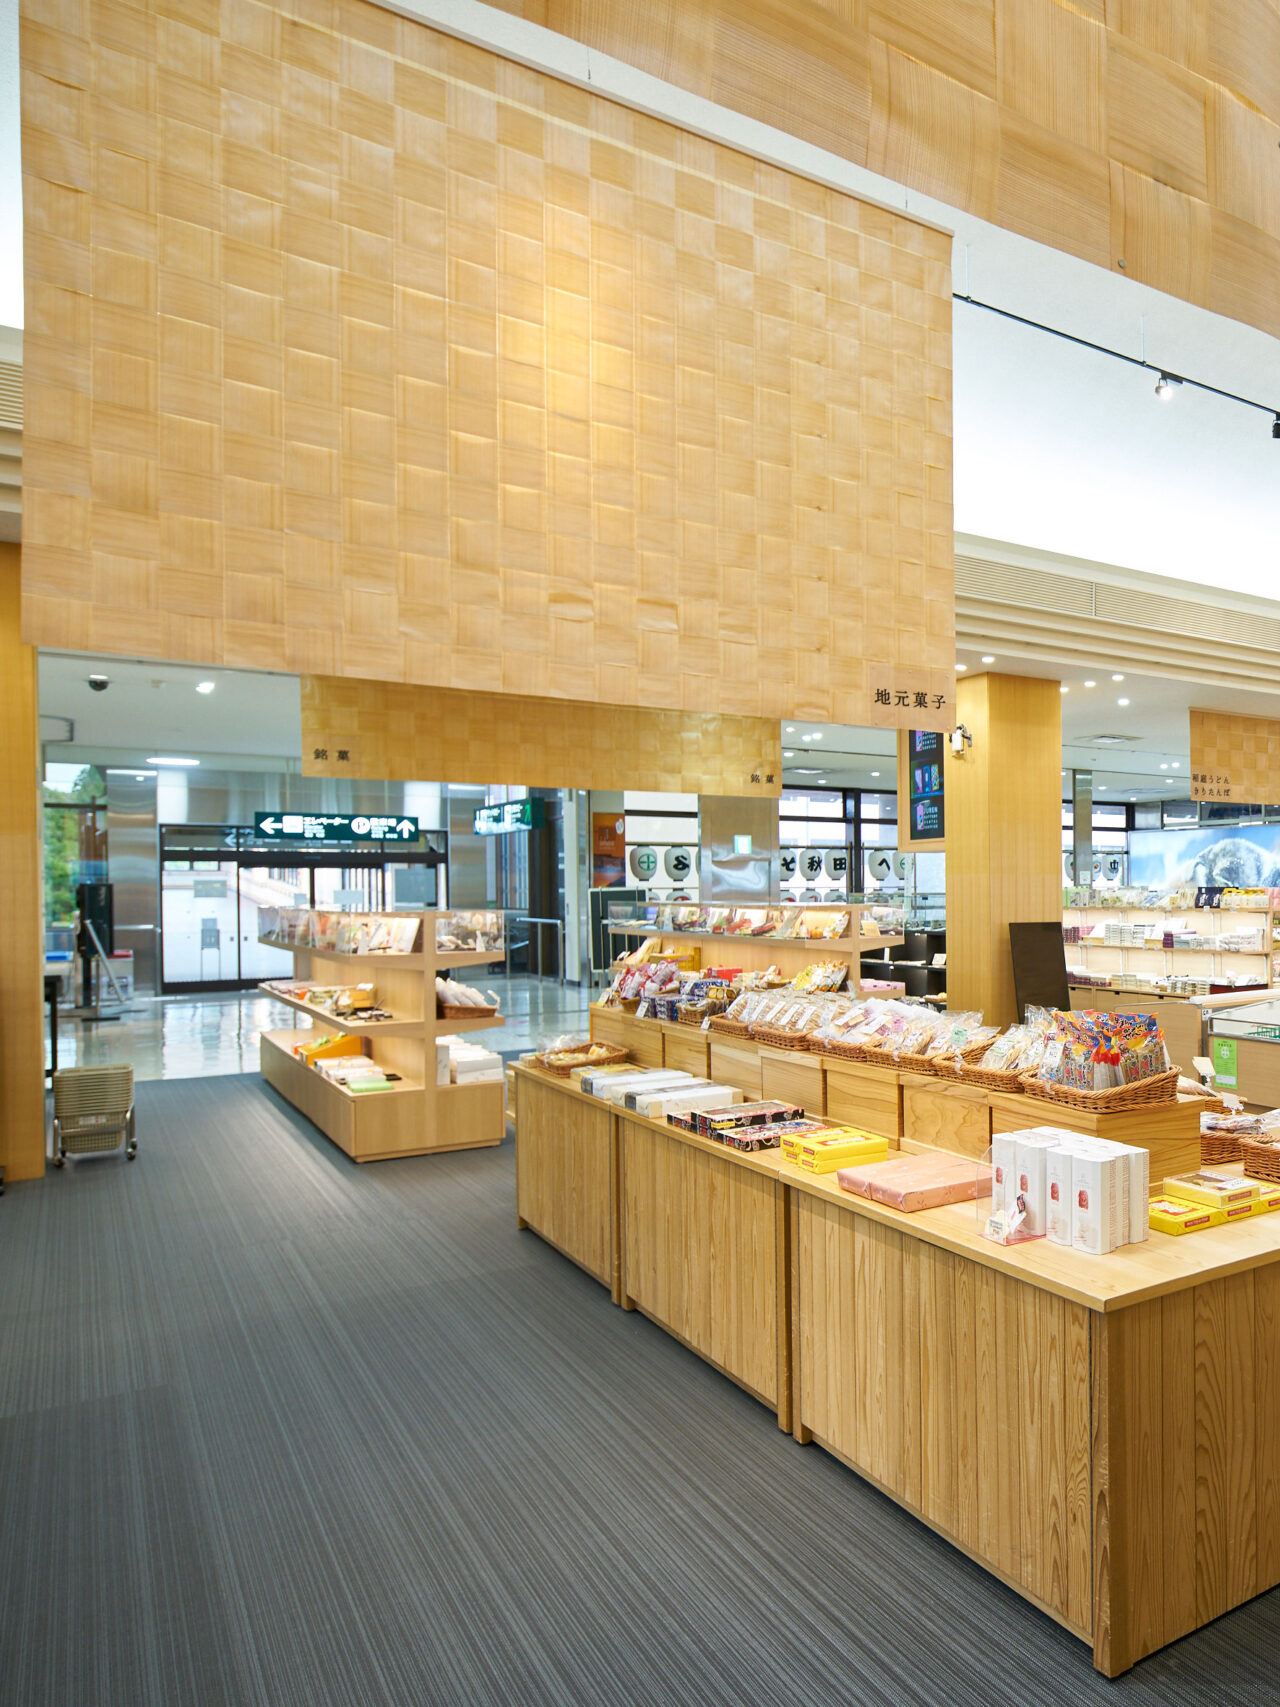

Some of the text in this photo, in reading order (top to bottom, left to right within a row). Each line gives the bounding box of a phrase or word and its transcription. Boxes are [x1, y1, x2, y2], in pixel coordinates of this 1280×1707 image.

[873, 688, 946, 710] 地元菓子
[313, 748, 351, 762] 銘菓
[750, 773, 775, 784] 銘菓
[1194, 787, 1231, 797] きりたんぽ
